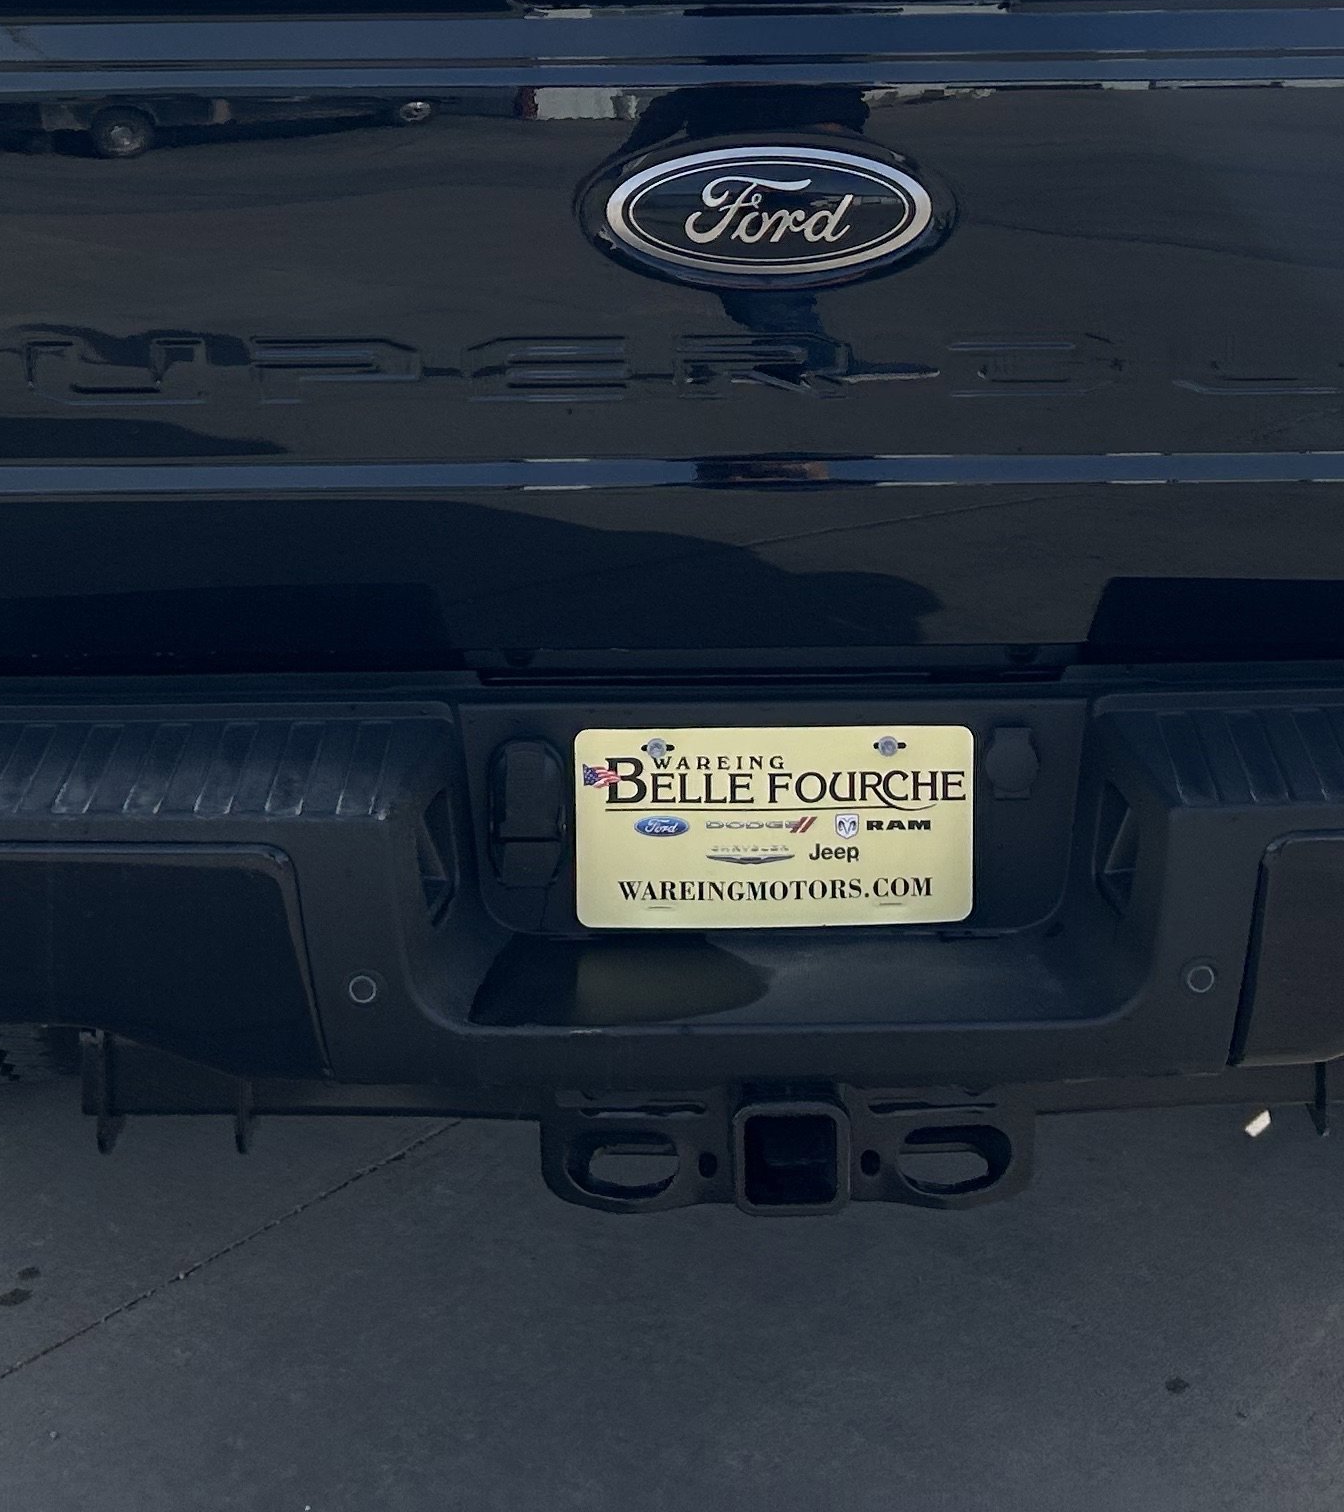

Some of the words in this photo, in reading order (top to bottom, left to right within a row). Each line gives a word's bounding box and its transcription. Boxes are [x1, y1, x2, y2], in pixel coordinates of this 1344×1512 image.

[684, 175, 854, 244] Ford
[653, 756, 784, 771] WAREING
[605, 757, 754, 804] BELLE
[768, 770, 966, 808] FOURCHE
[644, 818, 678, 834] Ford
[706, 820, 798, 831] DODGE
[866, 820, 931, 831] RAM
[809, 843, 860, 862] Jeep
[618, 876, 934, 901] WAREINGMOTORS.COM
